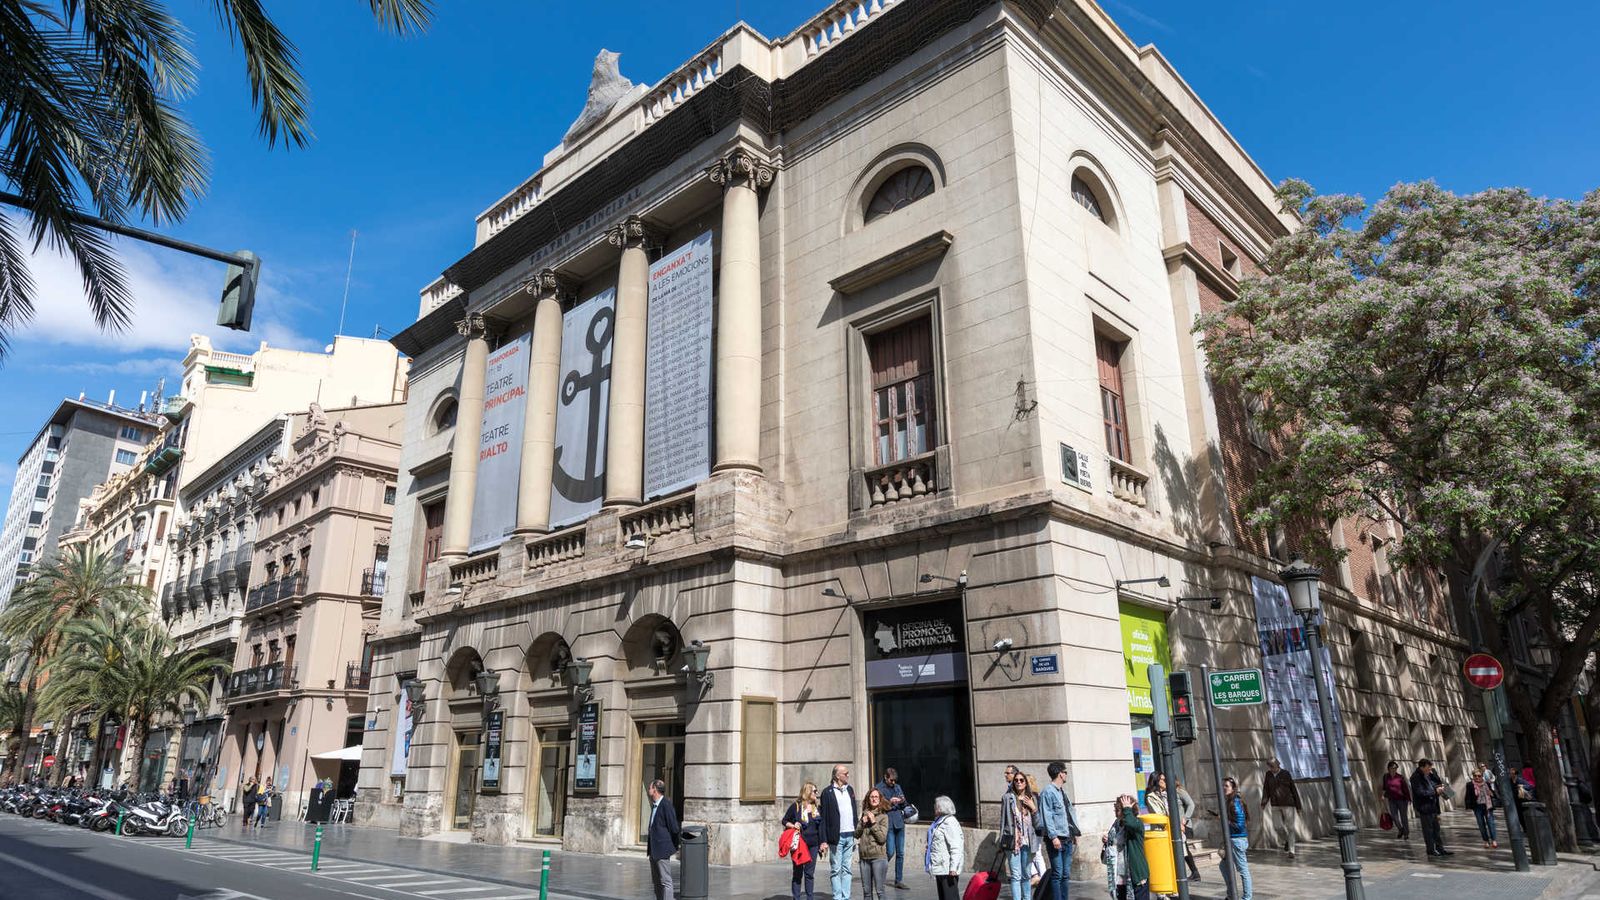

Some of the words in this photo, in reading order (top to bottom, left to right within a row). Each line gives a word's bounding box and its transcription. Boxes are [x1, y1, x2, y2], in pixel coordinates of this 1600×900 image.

[578, 188, 641, 235] PRINCIPAL
[652, 252, 693, 280] ENGANXA'T
[652, 284, 658, 292] A
[659, 276, 670, 289] LES
[672, 254, 709, 282] EMOCIONS
[486, 374, 513, 395] TEATRE
[484, 384, 525, 411] PRINCIPAL
[481, 424, 509, 444] TEATRE
[480, 442, 508, 461] RIALTO
[902, 620, 932, 630] OFICINA
[934, 618, 944, 626] DE
[902, 624, 952, 638] PROMOCIÓ
[902, 634, 957, 648] PROVINCIAL
[1224, 674, 1255, 682] CARRER
[1228, 690, 1260, 698] BARQUES
